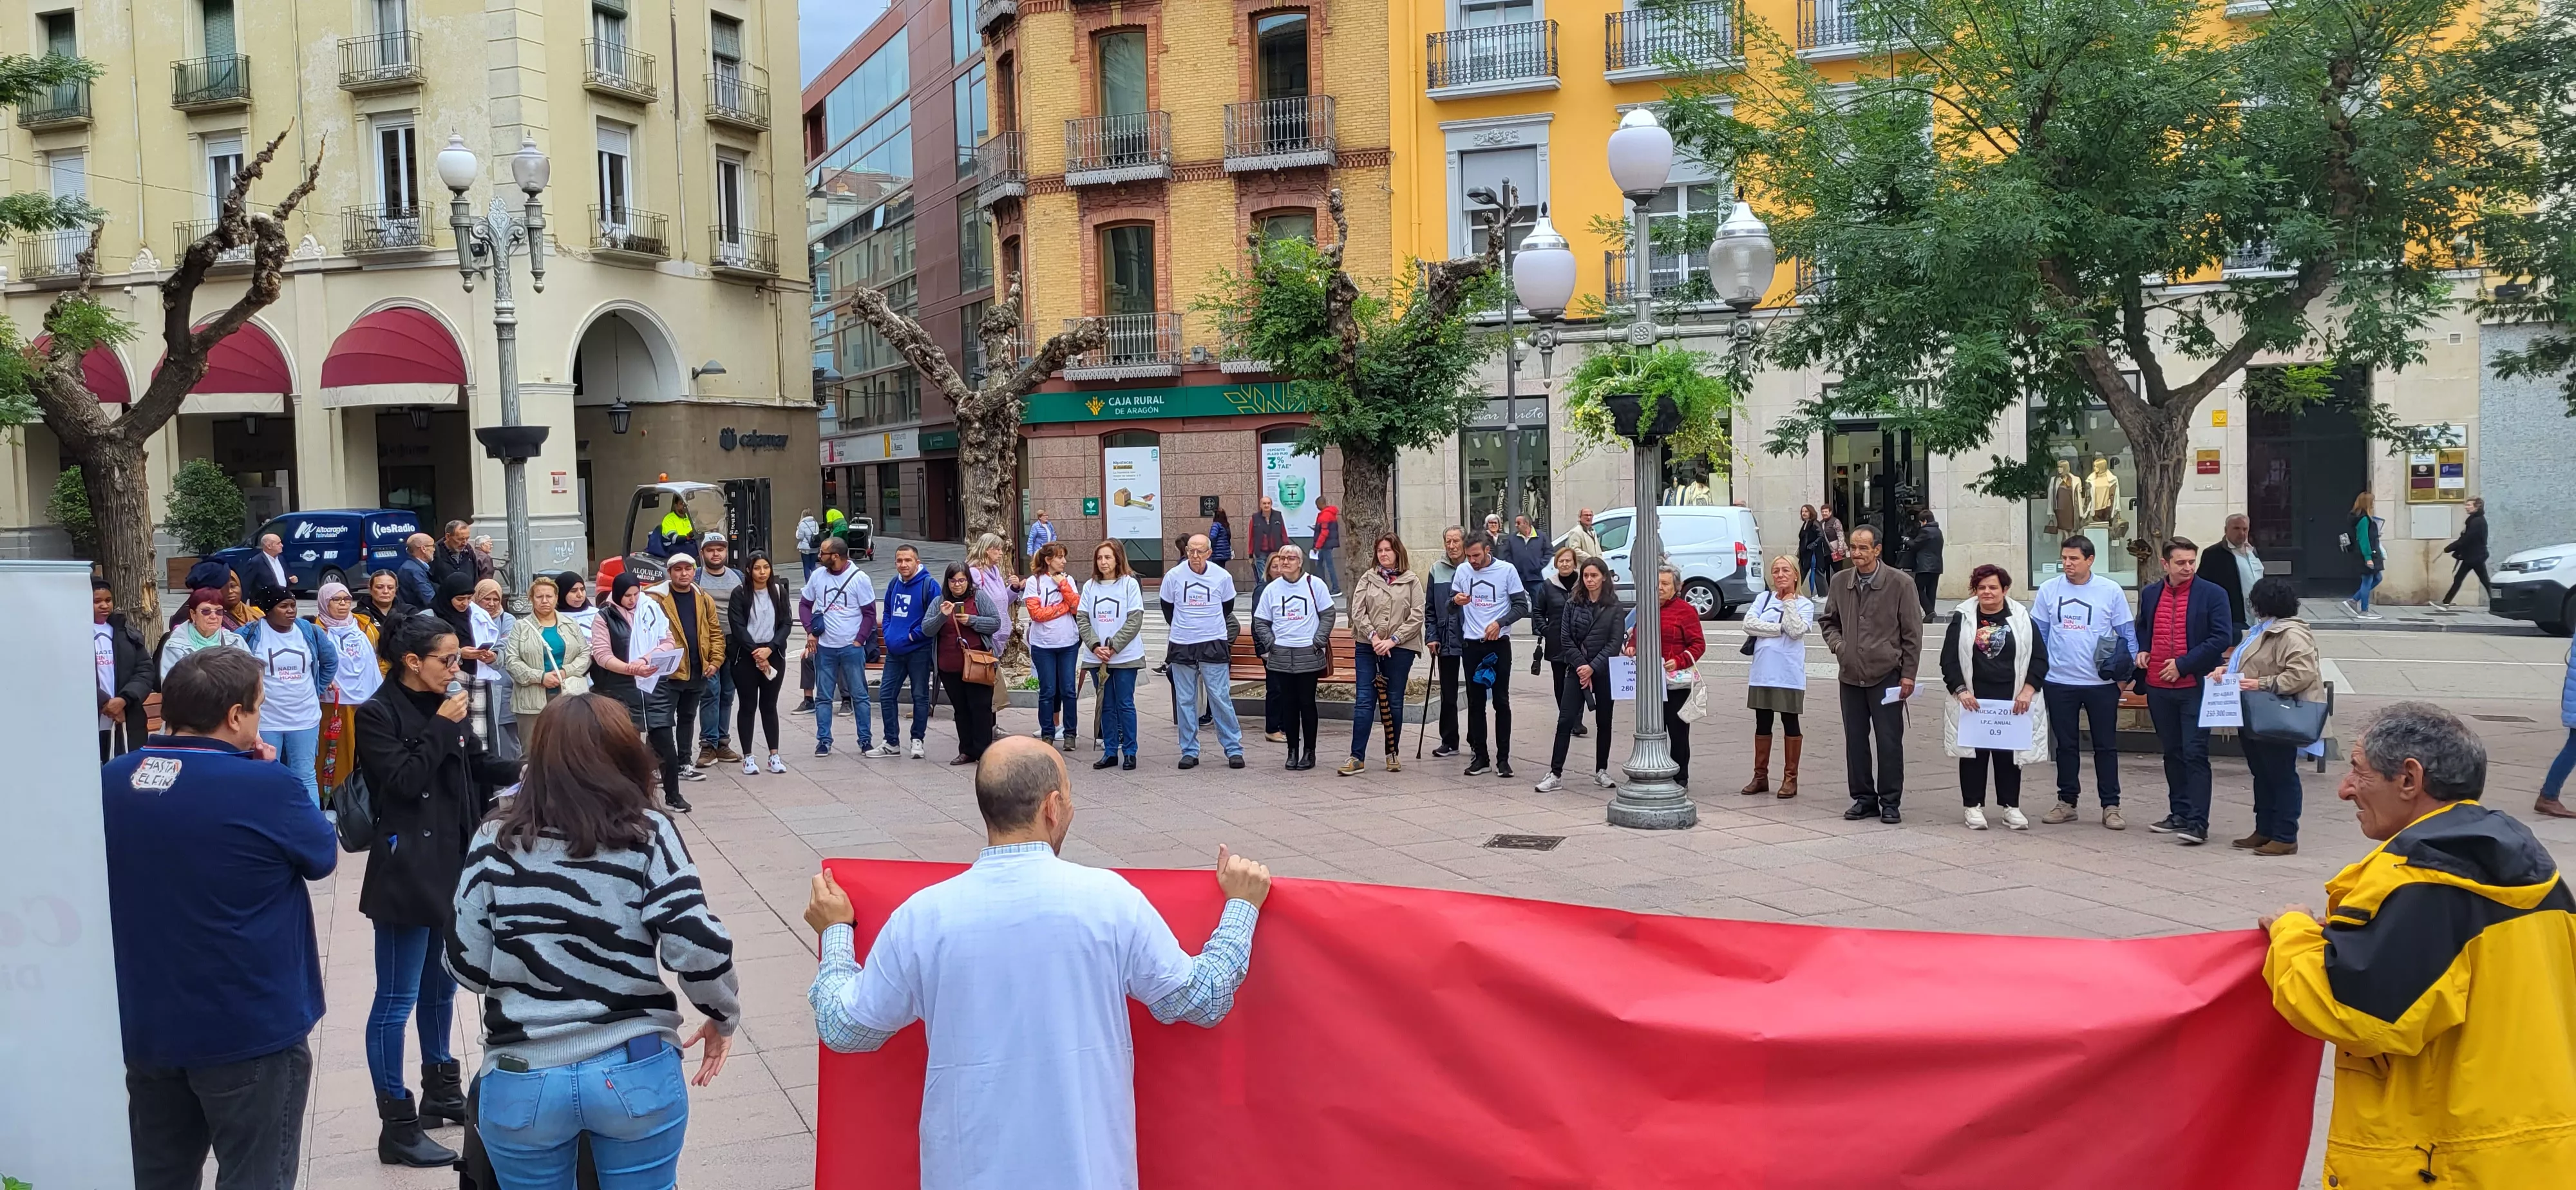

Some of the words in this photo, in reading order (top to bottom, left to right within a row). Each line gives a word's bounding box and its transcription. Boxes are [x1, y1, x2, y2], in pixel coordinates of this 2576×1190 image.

[2306, 348, 2315, 361] 2
[1108, 397, 1132, 406] CAJA
[1133, 395, 1164, 405] RURAL
[1127, 406, 1159, 414] ARAGÓN
[739, 429, 789, 452] cajamar
[316, 524, 348, 536] Altoaragón
[380, 523, 415, 534] esRadio
[632, 567, 663, 578] ALQUILER
[138, 773, 149, 784] EL
